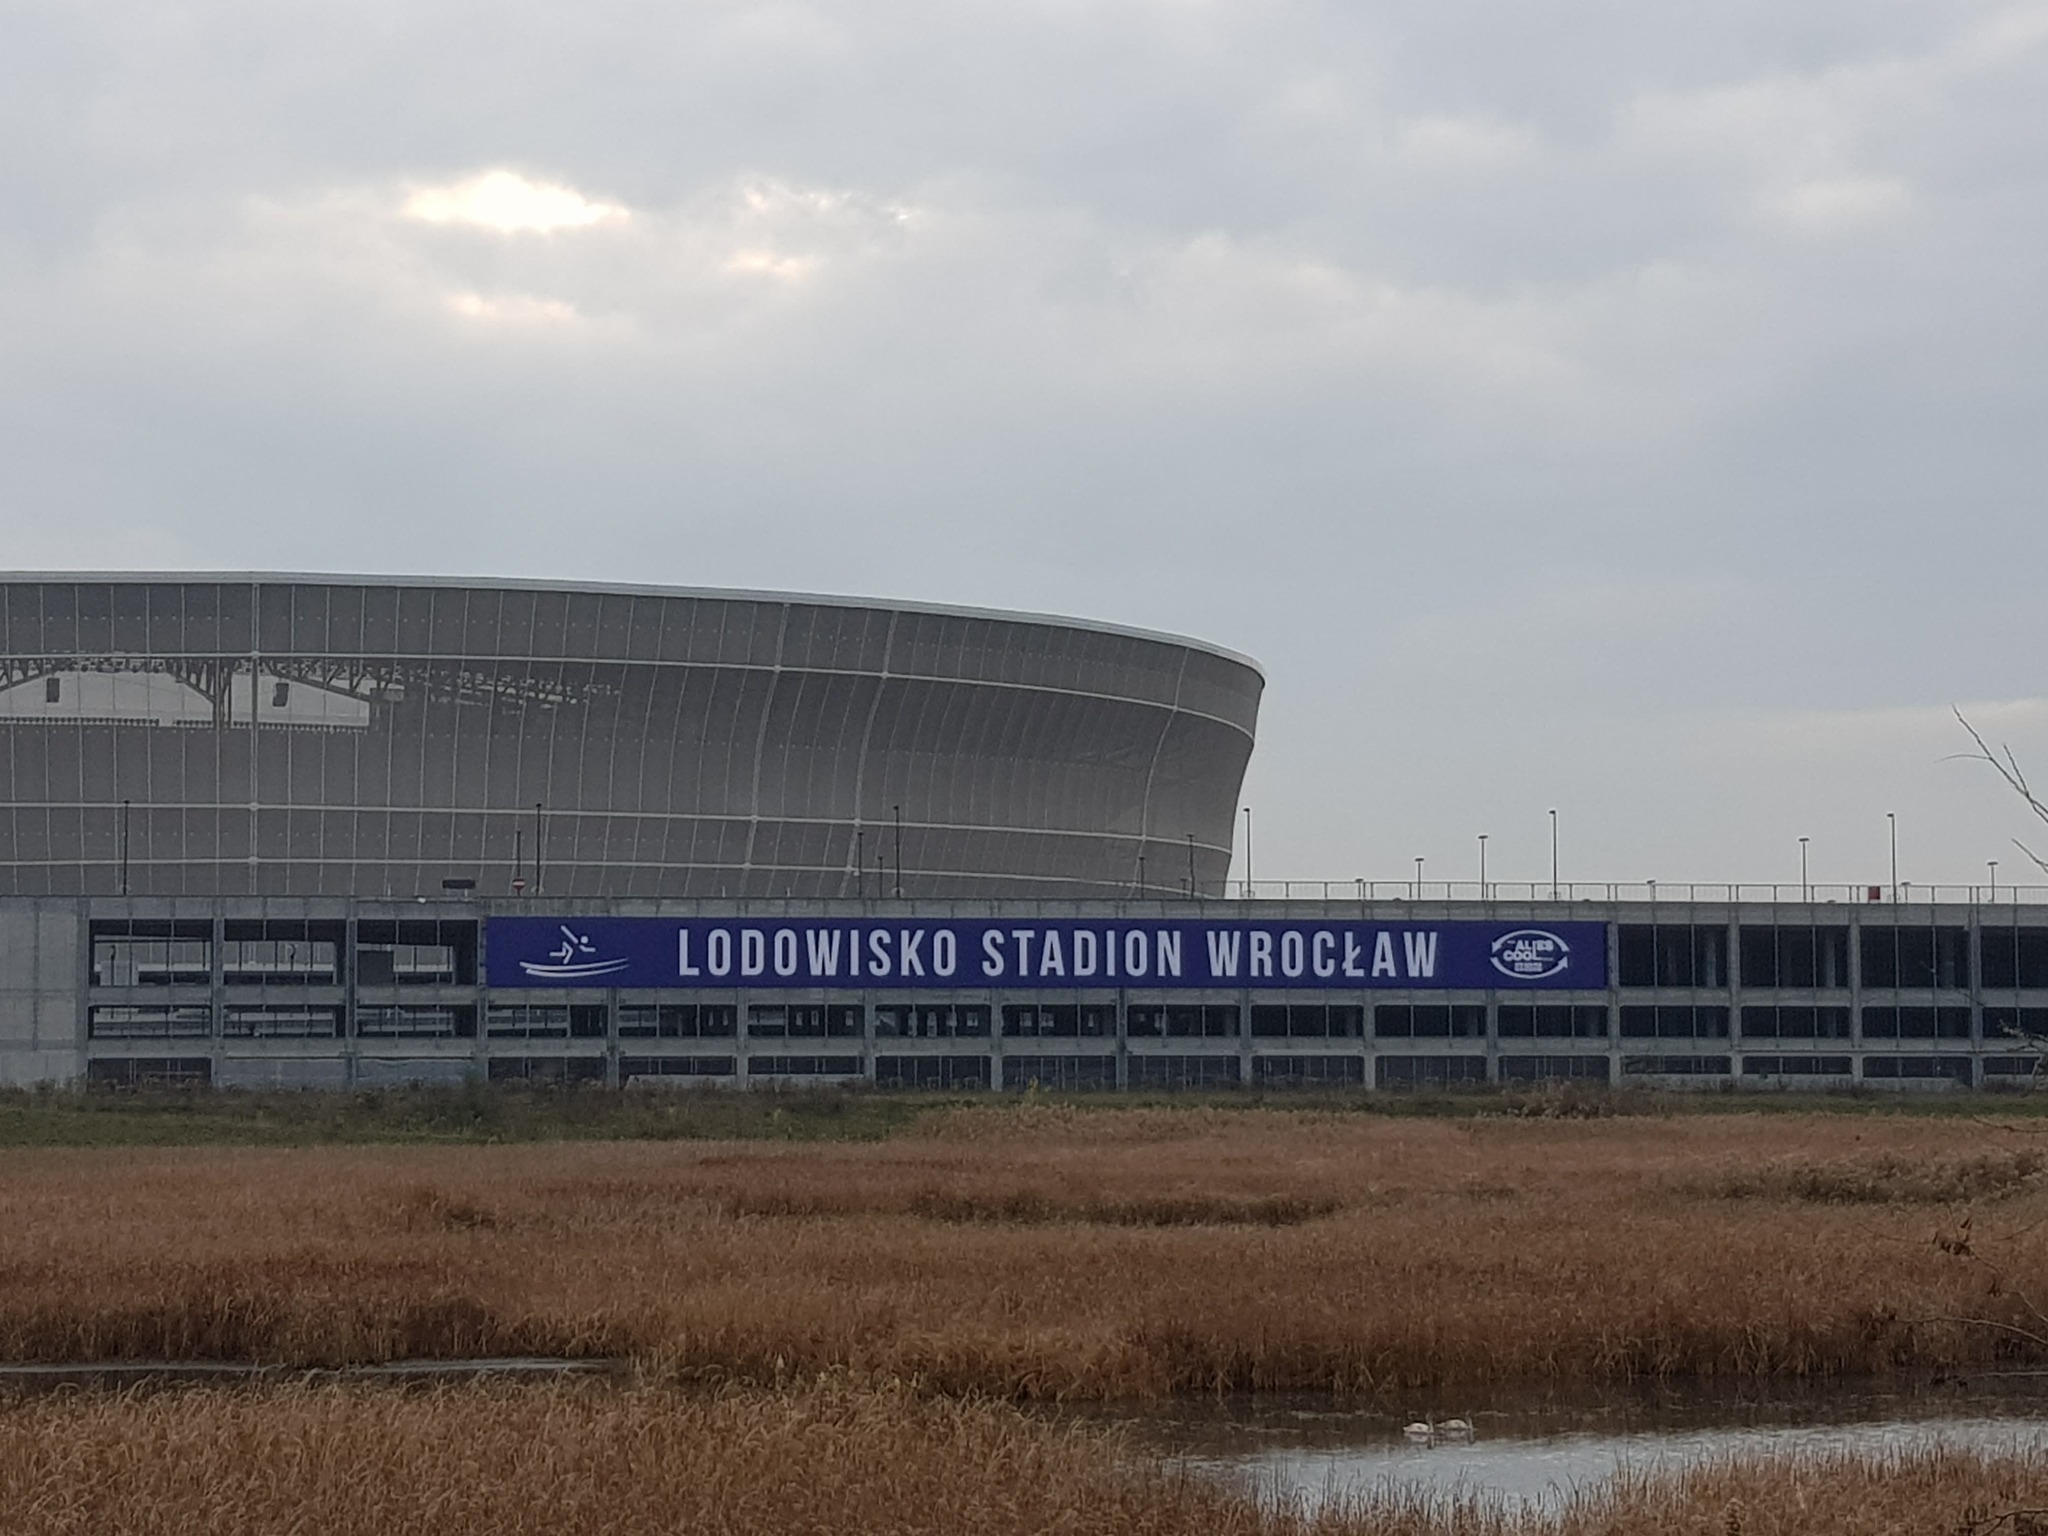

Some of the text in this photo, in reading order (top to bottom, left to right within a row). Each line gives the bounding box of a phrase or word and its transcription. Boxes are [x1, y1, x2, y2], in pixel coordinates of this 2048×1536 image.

[678, 928, 1438, 978] LODOWISKO STADION WROCŁAW
